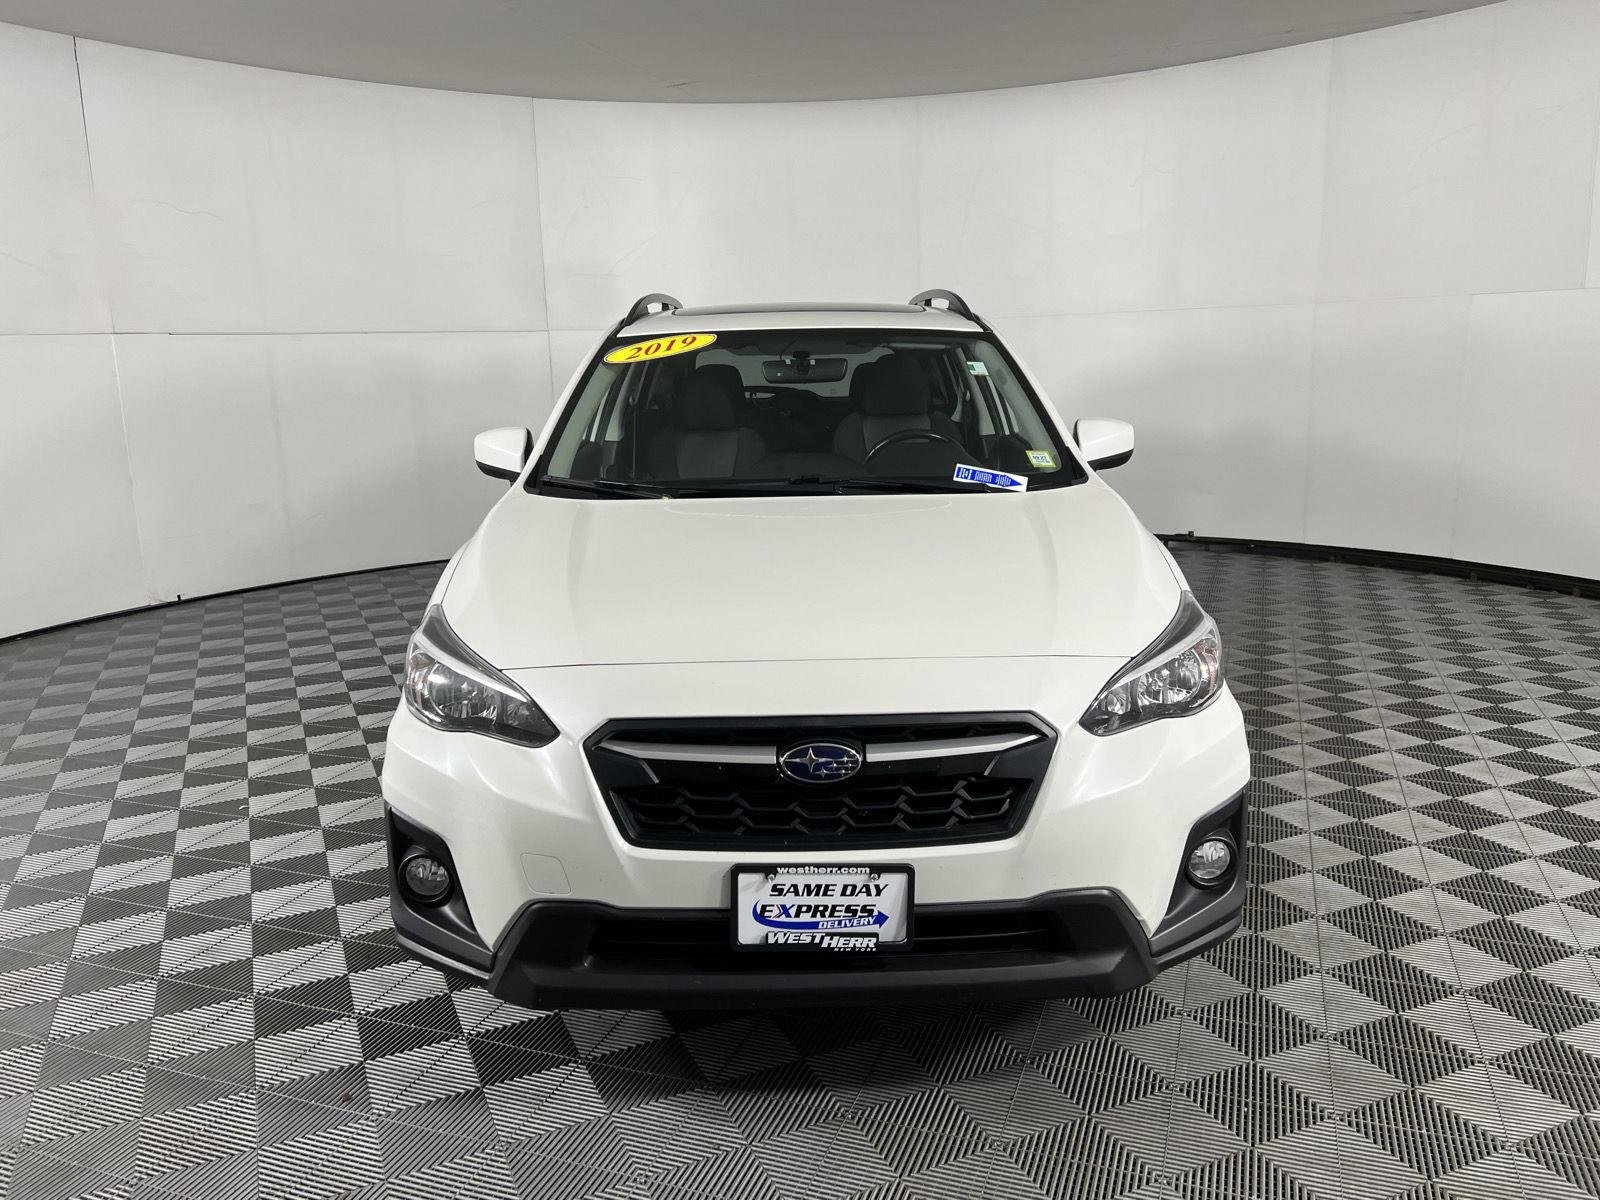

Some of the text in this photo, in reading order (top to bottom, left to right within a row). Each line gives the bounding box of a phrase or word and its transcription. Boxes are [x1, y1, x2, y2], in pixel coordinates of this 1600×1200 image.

[626, 336, 697, 360] 2019
[777, 866, 870, 874] westherr.com
[770, 884, 888, 897] SAME DAY
[759, 904, 876, 919] EXPRESS
[818, 916, 876, 929] DELIVERY
[768, 932, 878, 948] WEST HERR
